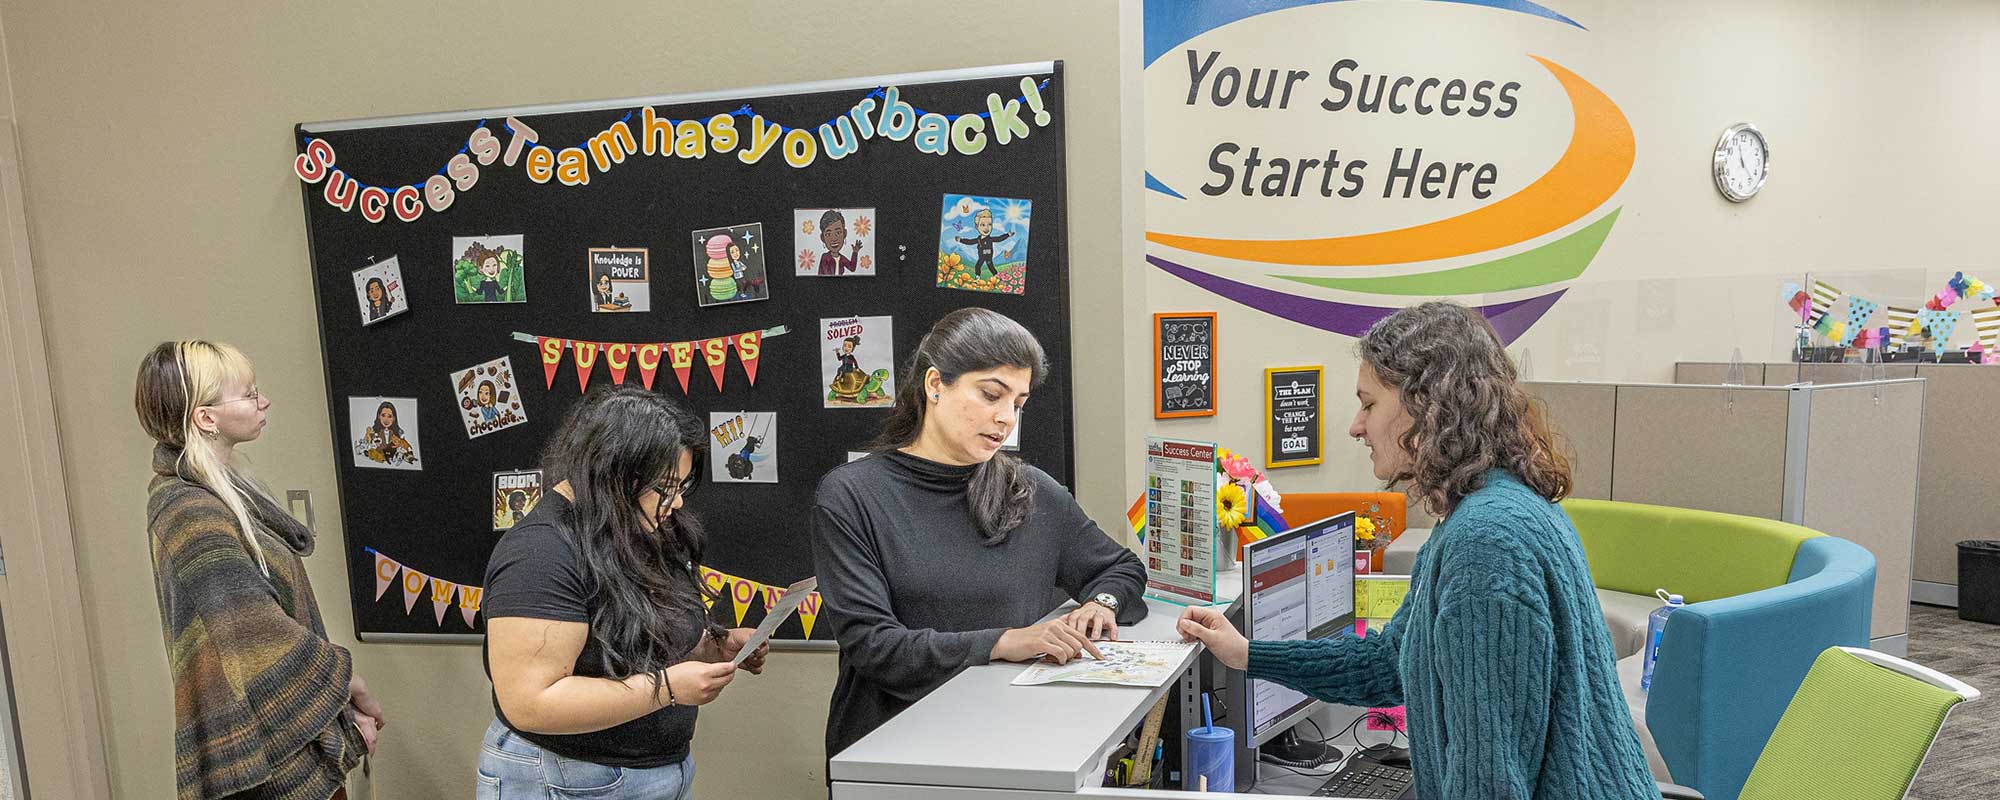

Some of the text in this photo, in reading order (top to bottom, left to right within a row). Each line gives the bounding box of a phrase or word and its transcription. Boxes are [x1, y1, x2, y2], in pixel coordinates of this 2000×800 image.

[1186, 49, 1522, 118] Your Success
[295, 76, 1051, 223] Success Team has your back!
[1200, 142, 1498, 200] Starts Here
[594, 253, 633, 267] Knowledge
[611, 267, 640, 278] POWER
[827, 325, 863, 341] SOLVED
[543, 331, 760, 370] SUCCESS
[1163, 344, 1209, 360] NEVER
[1176, 360, 1202, 371] STOP
[1162, 364, 1210, 385] Learning
[1279, 386, 1312, 396] THE PLAN
[1283, 410, 1307, 418] CHANGE
[1164, 443, 1190, 457] Success
[1190, 447, 1213, 459] Center
[1283, 440, 1306, 449] GOAL
